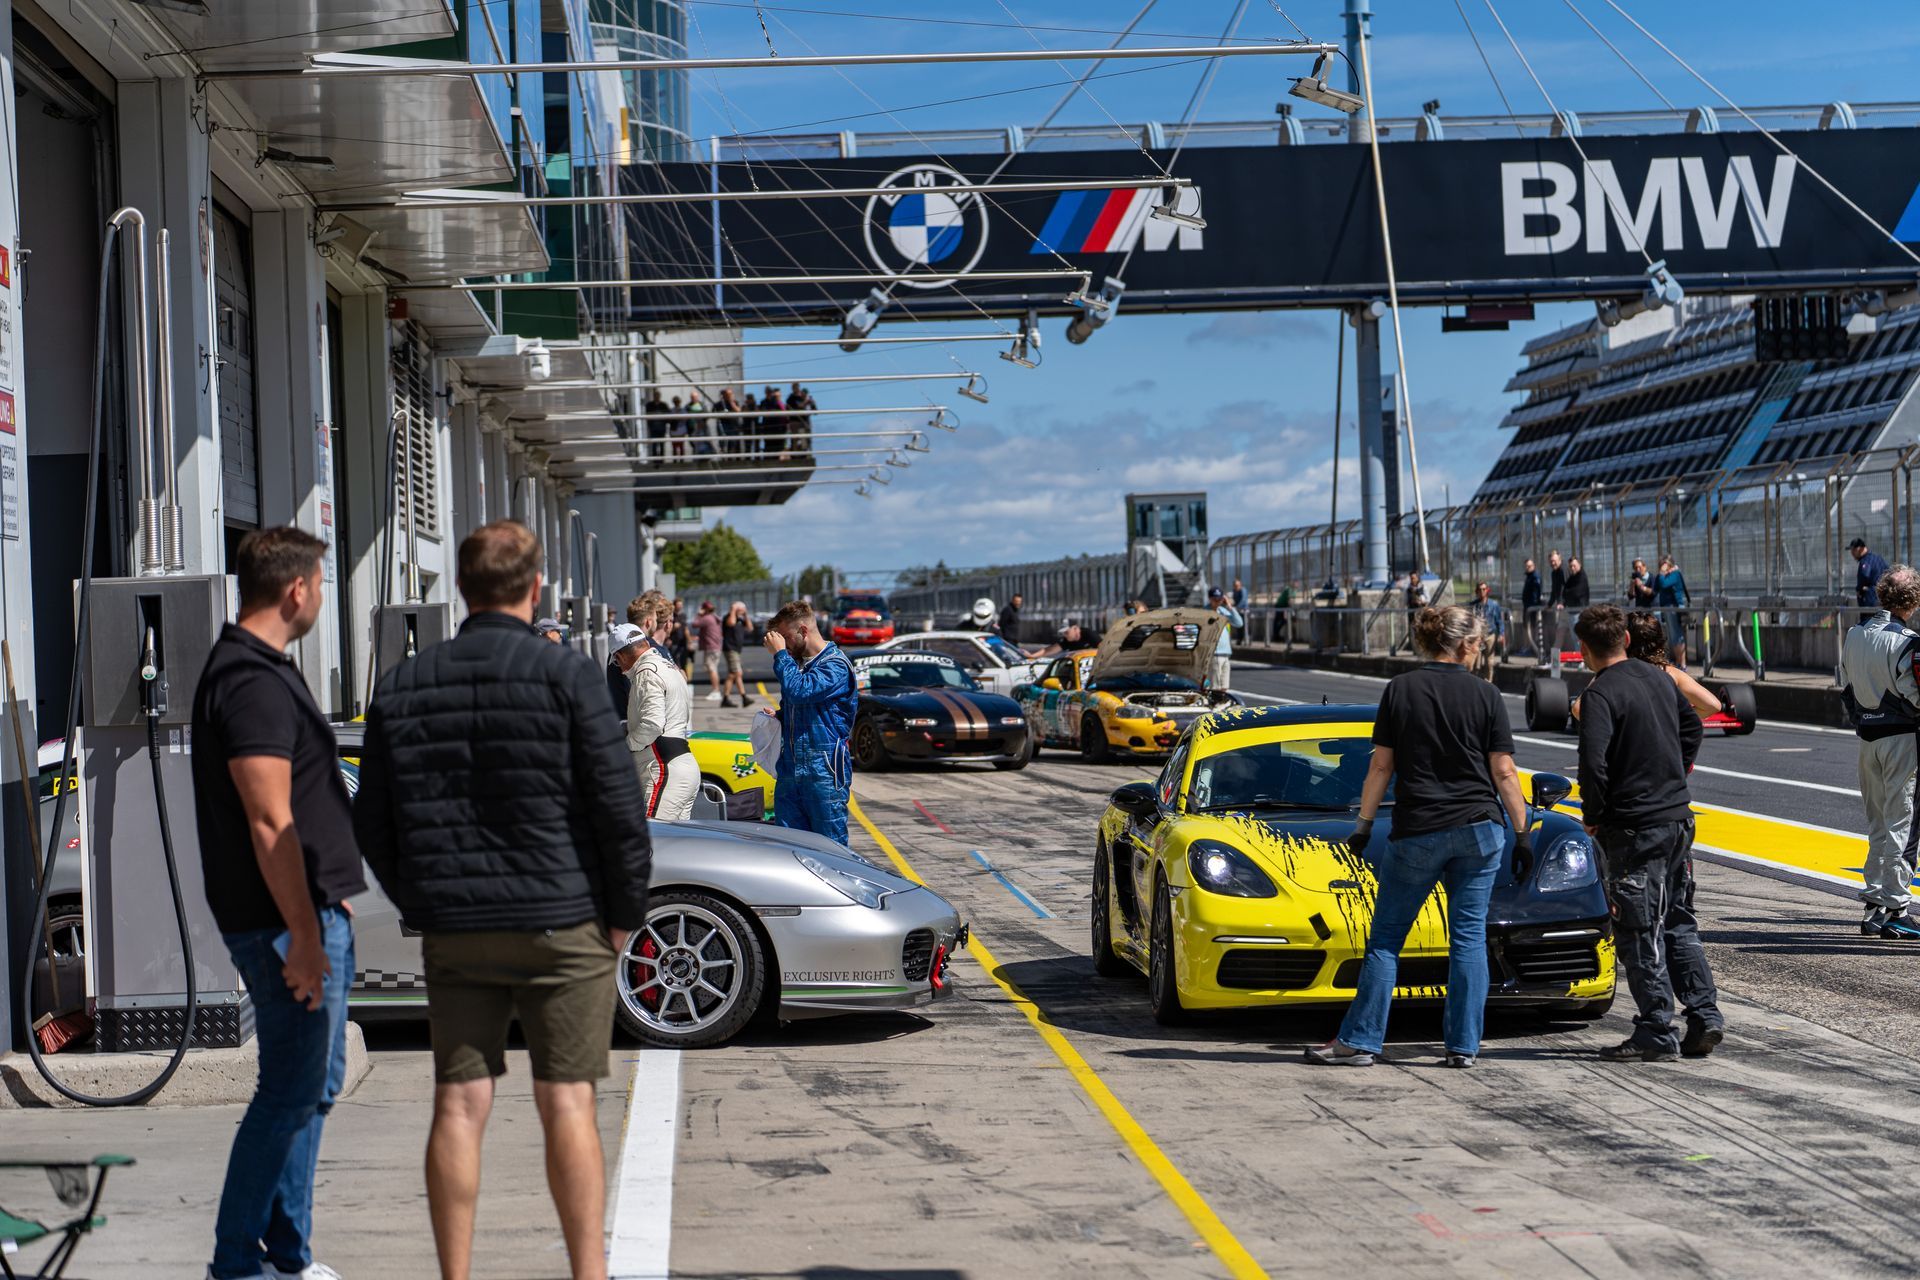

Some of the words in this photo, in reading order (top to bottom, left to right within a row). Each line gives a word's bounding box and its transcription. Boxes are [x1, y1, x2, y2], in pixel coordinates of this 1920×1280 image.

[1500, 154, 1797, 256] BMW
[783, 971, 850, 982] EXCLUSIVE
[852, 969, 896, 981] RIGHTS
